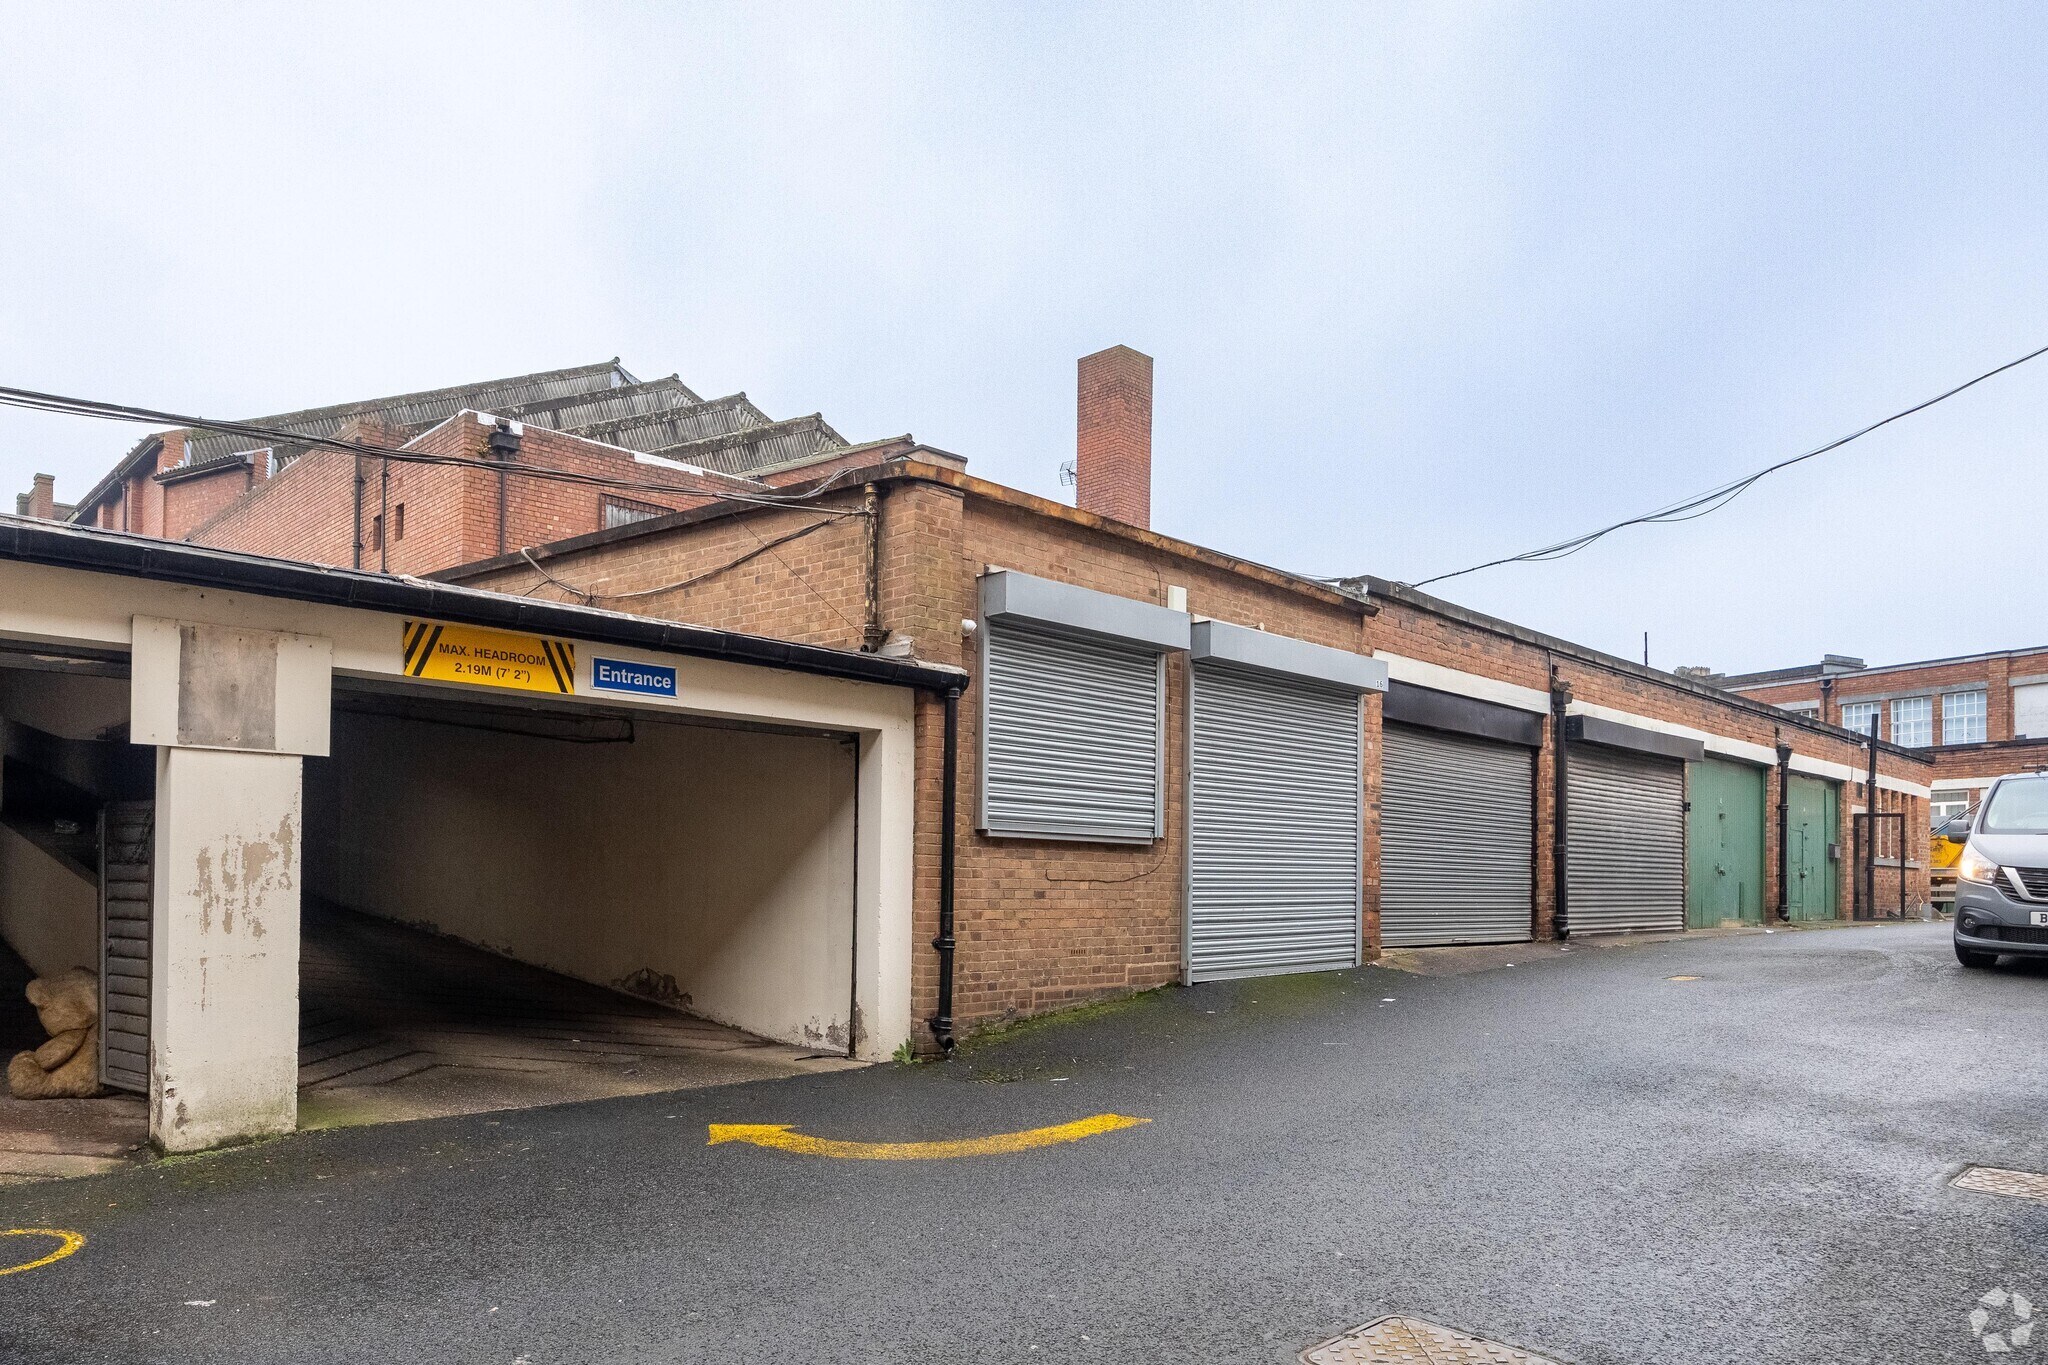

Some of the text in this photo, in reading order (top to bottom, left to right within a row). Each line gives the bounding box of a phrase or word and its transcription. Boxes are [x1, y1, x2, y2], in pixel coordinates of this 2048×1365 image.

[439, 643, 546, 666] MAX. HEADROOM
[454, 662, 492, 676] 2.19M
[599, 665, 672, 689] Entrance
